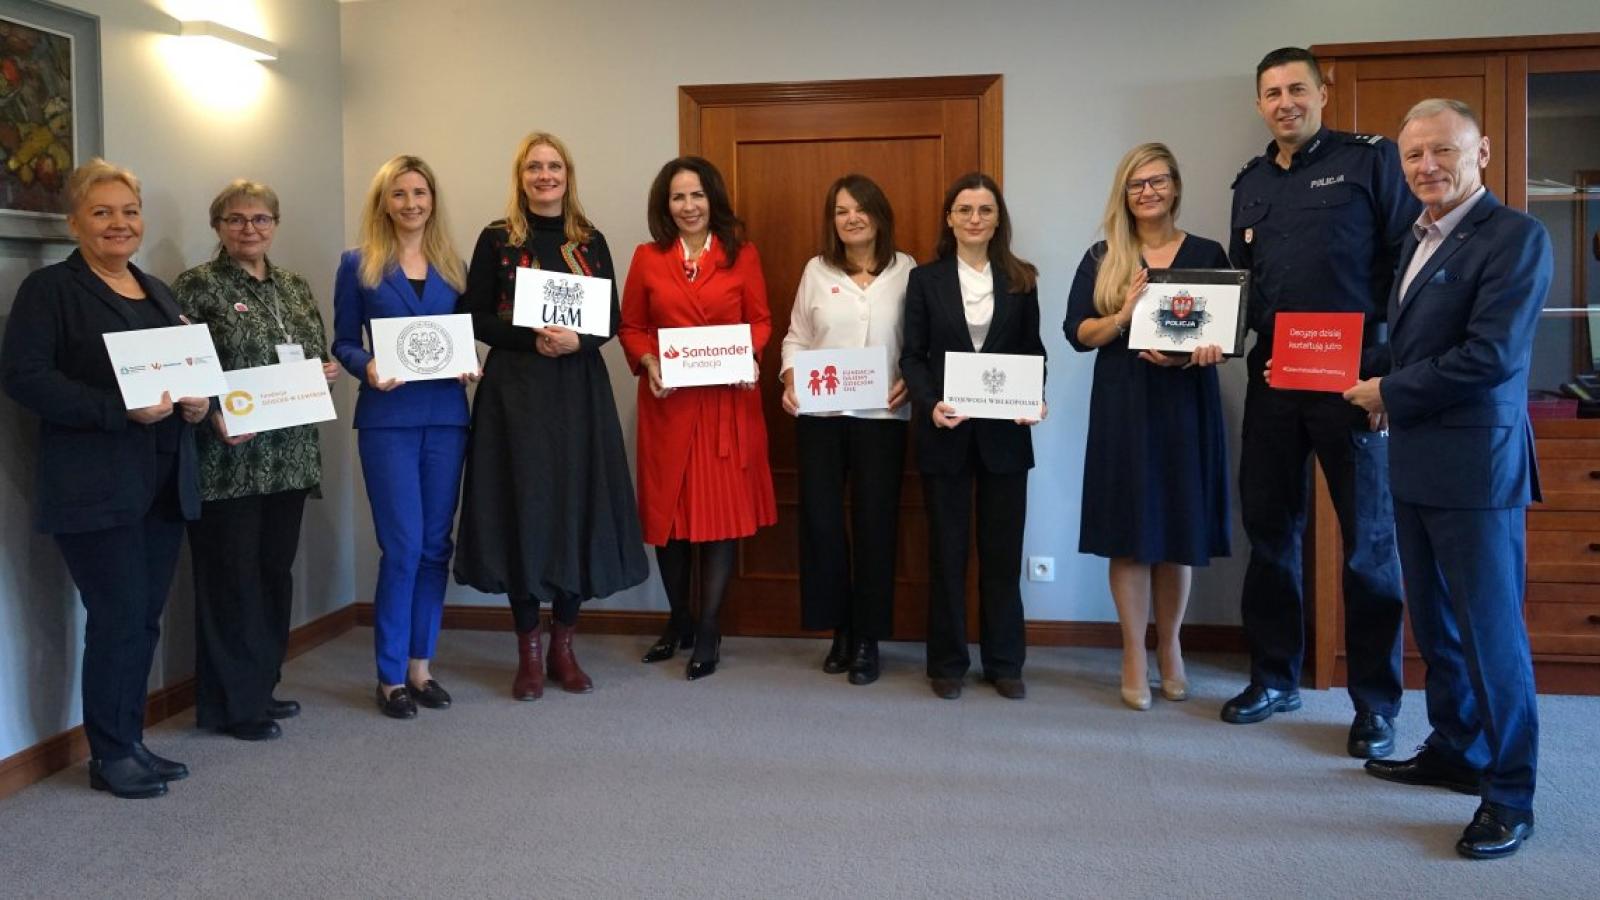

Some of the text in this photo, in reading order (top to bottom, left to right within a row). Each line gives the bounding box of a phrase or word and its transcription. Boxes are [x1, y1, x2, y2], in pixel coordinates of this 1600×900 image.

[1310, 175, 1345, 188] POLICJA
[1164, 320, 1196, 328] POLICJA
[682, 344, 749, 359] Santander
[1323, 343, 1343, 352] jutro
[682, 360, 722, 369] Fundacja
